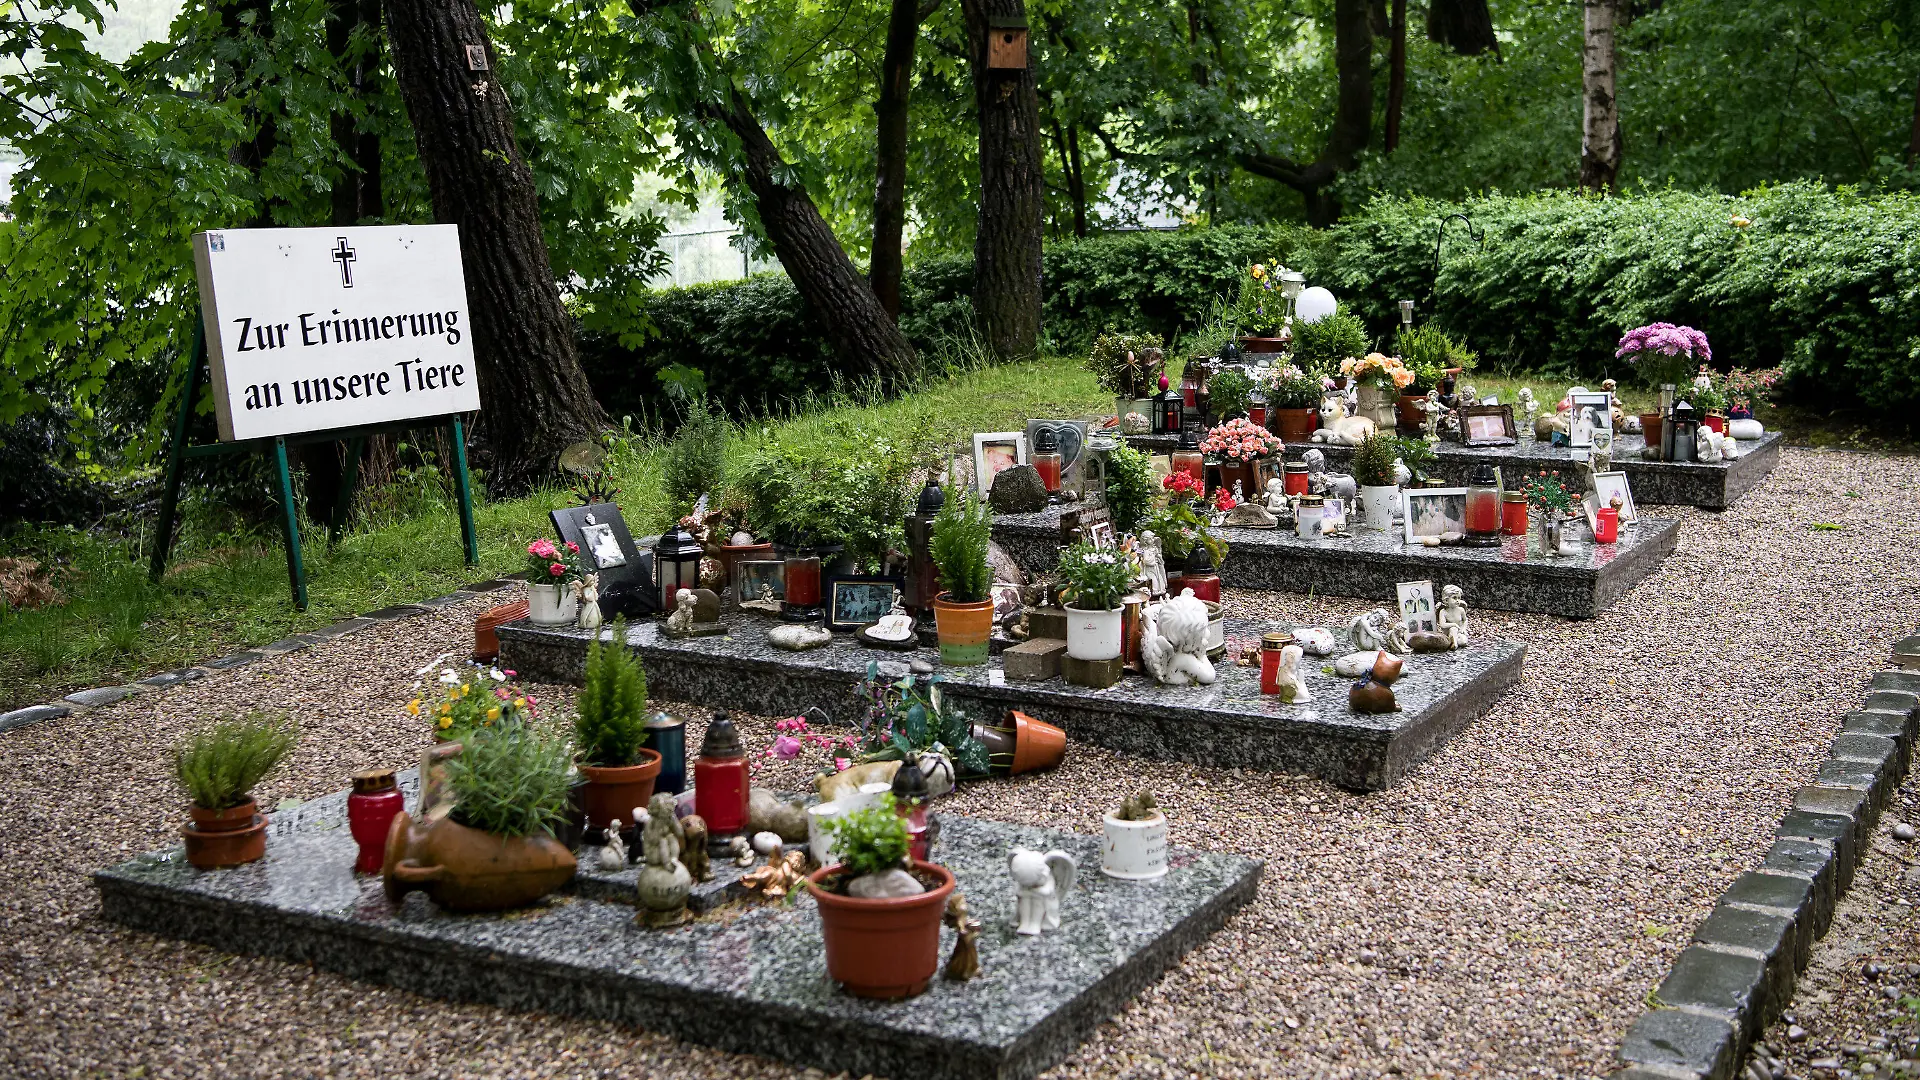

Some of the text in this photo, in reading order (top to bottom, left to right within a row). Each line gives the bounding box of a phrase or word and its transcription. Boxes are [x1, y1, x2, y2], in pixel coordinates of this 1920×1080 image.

[233, 308, 461, 353] Zur Erinnerung
[244, 357, 467, 411] an unsere Tiere
